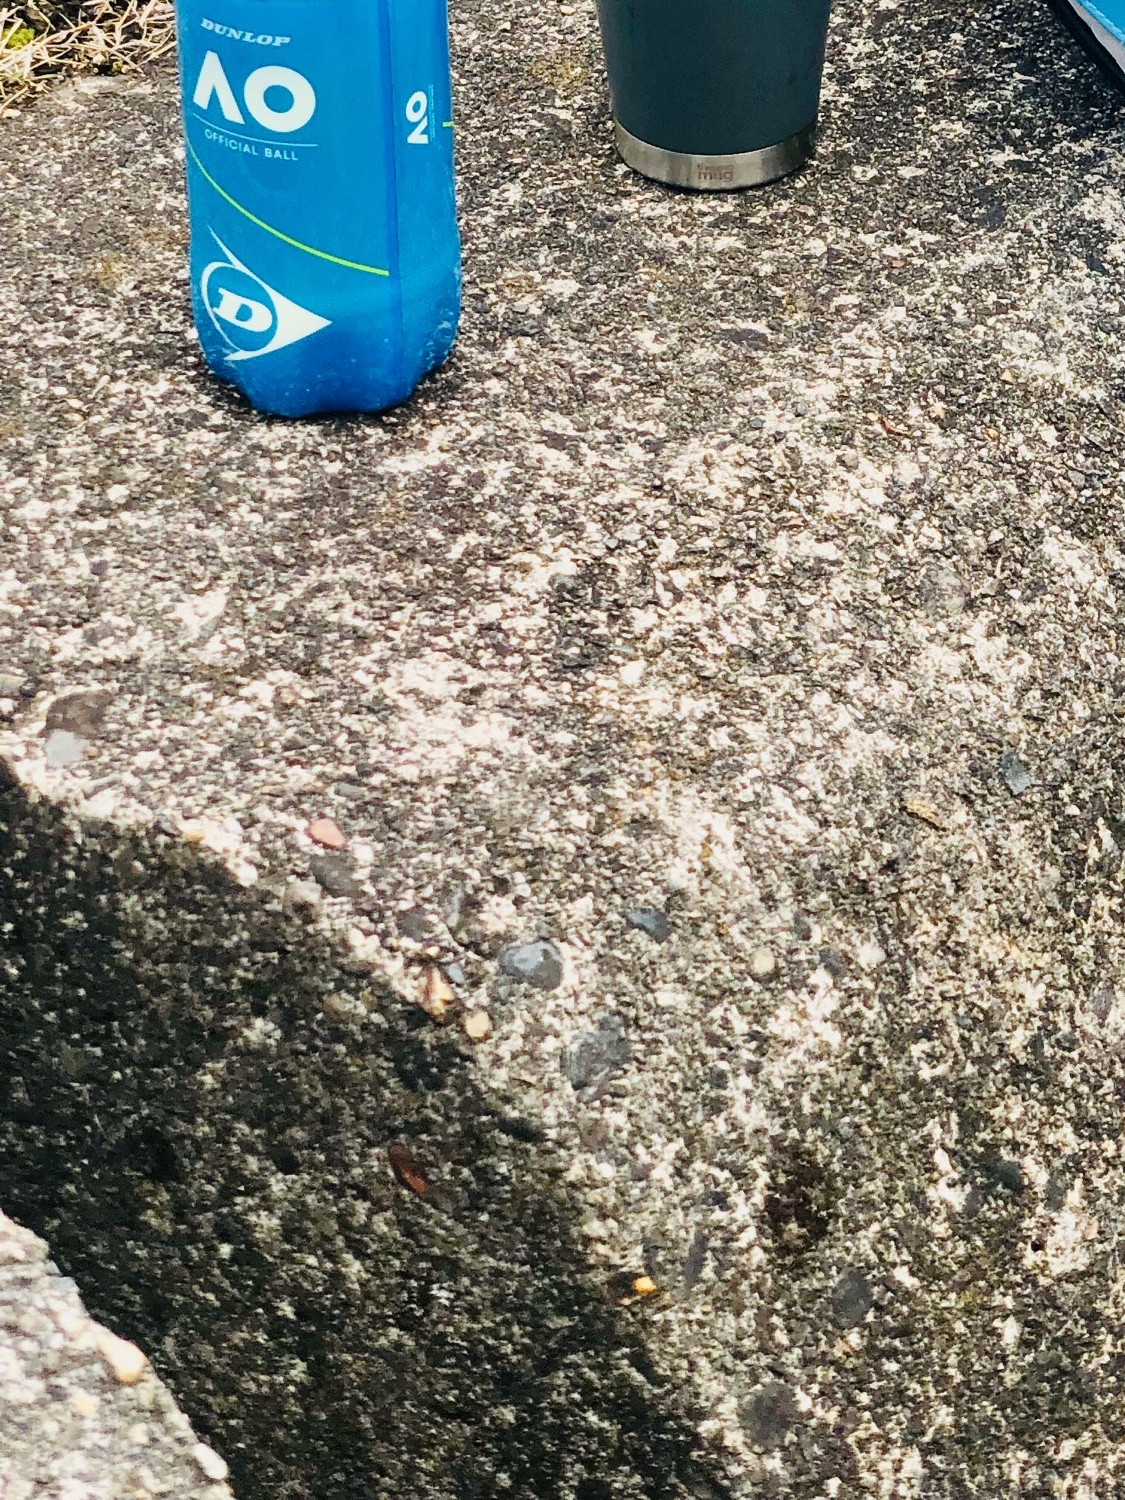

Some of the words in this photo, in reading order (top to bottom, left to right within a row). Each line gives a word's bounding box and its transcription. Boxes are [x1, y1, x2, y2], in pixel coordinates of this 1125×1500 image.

[201, 17, 291, 47] DUNLOP
[193, 50, 317, 133] AO
[204, 128, 259, 155] OFFICIAL
[264, 147, 299, 160] BALL
[212, 287, 273, 333] D
